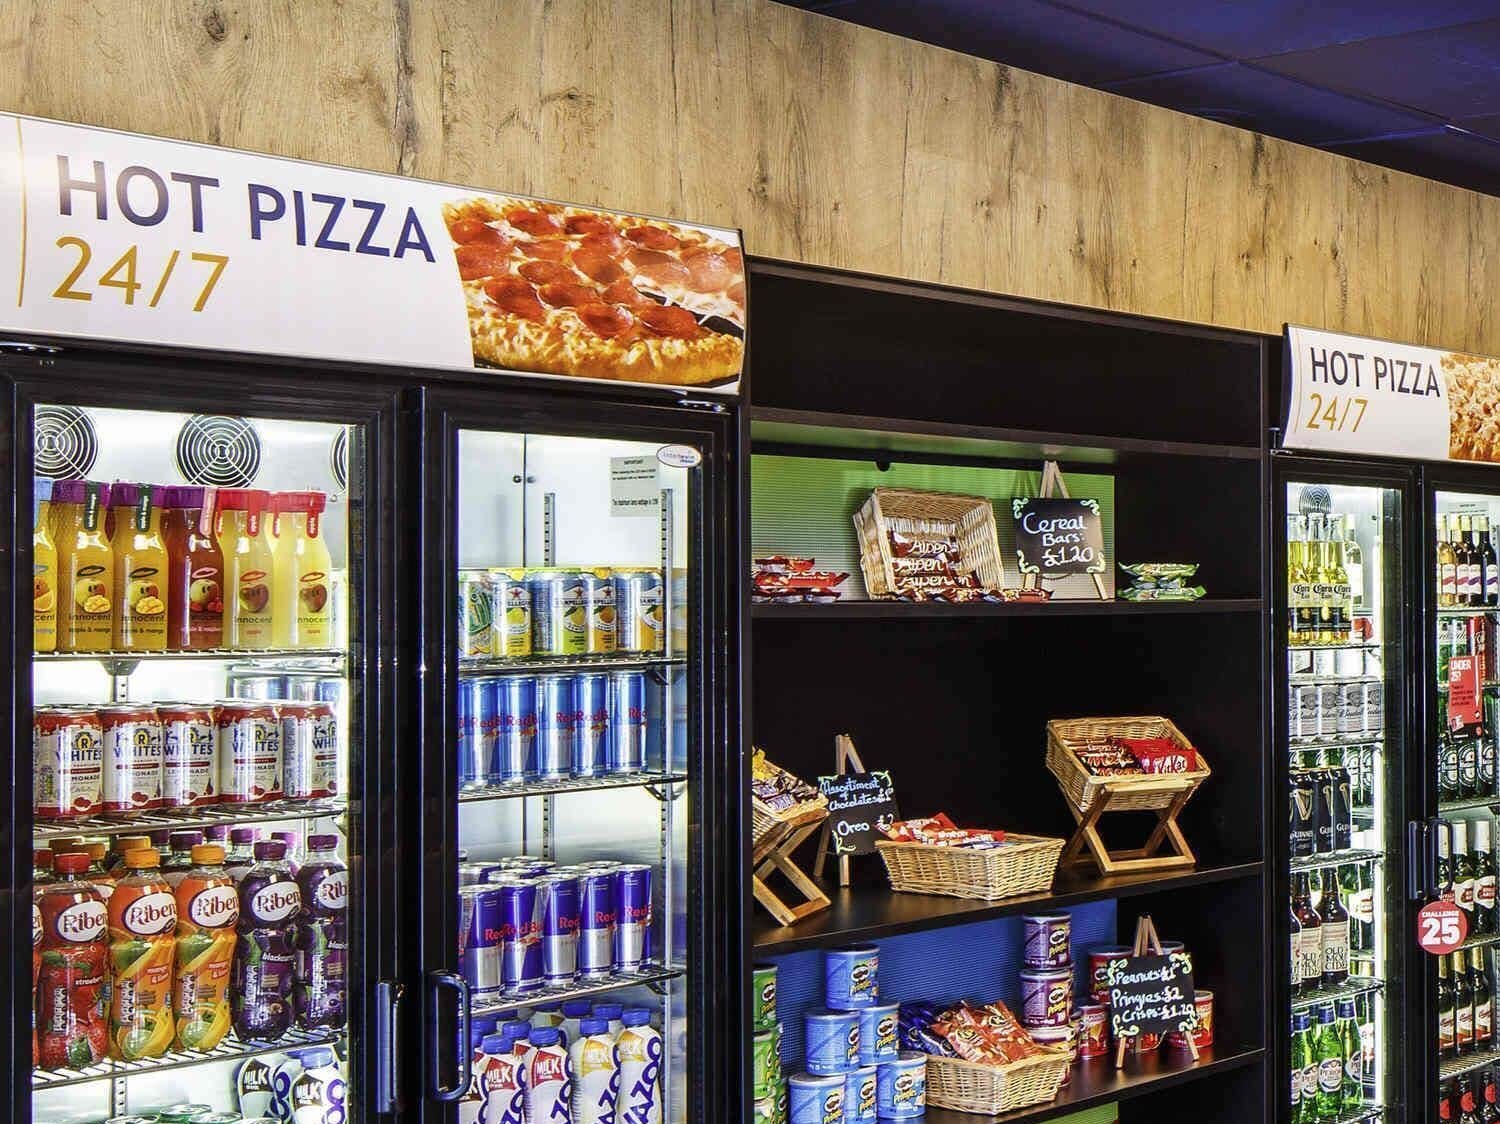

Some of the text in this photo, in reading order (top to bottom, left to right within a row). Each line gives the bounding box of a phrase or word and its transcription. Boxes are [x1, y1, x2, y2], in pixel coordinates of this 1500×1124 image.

[55, 154, 437, 264] HOT PIZZA
[52, 234, 230, 314] 24/7
[1310, 346, 1441, 398] HOT PIZZA
[1307, 391, 1369, 433] 24/7
[1022, 512, 1087, 535] Cereal
[908, 540, 951, 554] Alpen
[1042, 532, 1085, 547] Bars:
[68, 613, 113, 623] innocent
[312, 738, 337, 751] WHI
[316, 760, 337, 768] LEMON
[837, 820, 870, 837] Oreo
[256, 890, 301, 911] Riben
[323, 882, 348, 902] Rib
[197, 893, 240, 917] Riben
[1421, 910, 1460, 918] CHALLENGE
[130, 905, 176, 927] Riben
[559, 916, 580, 928] Red
[1421, 917, 1461, 946] 25
[535, 1059, 561, 1076] MILK
